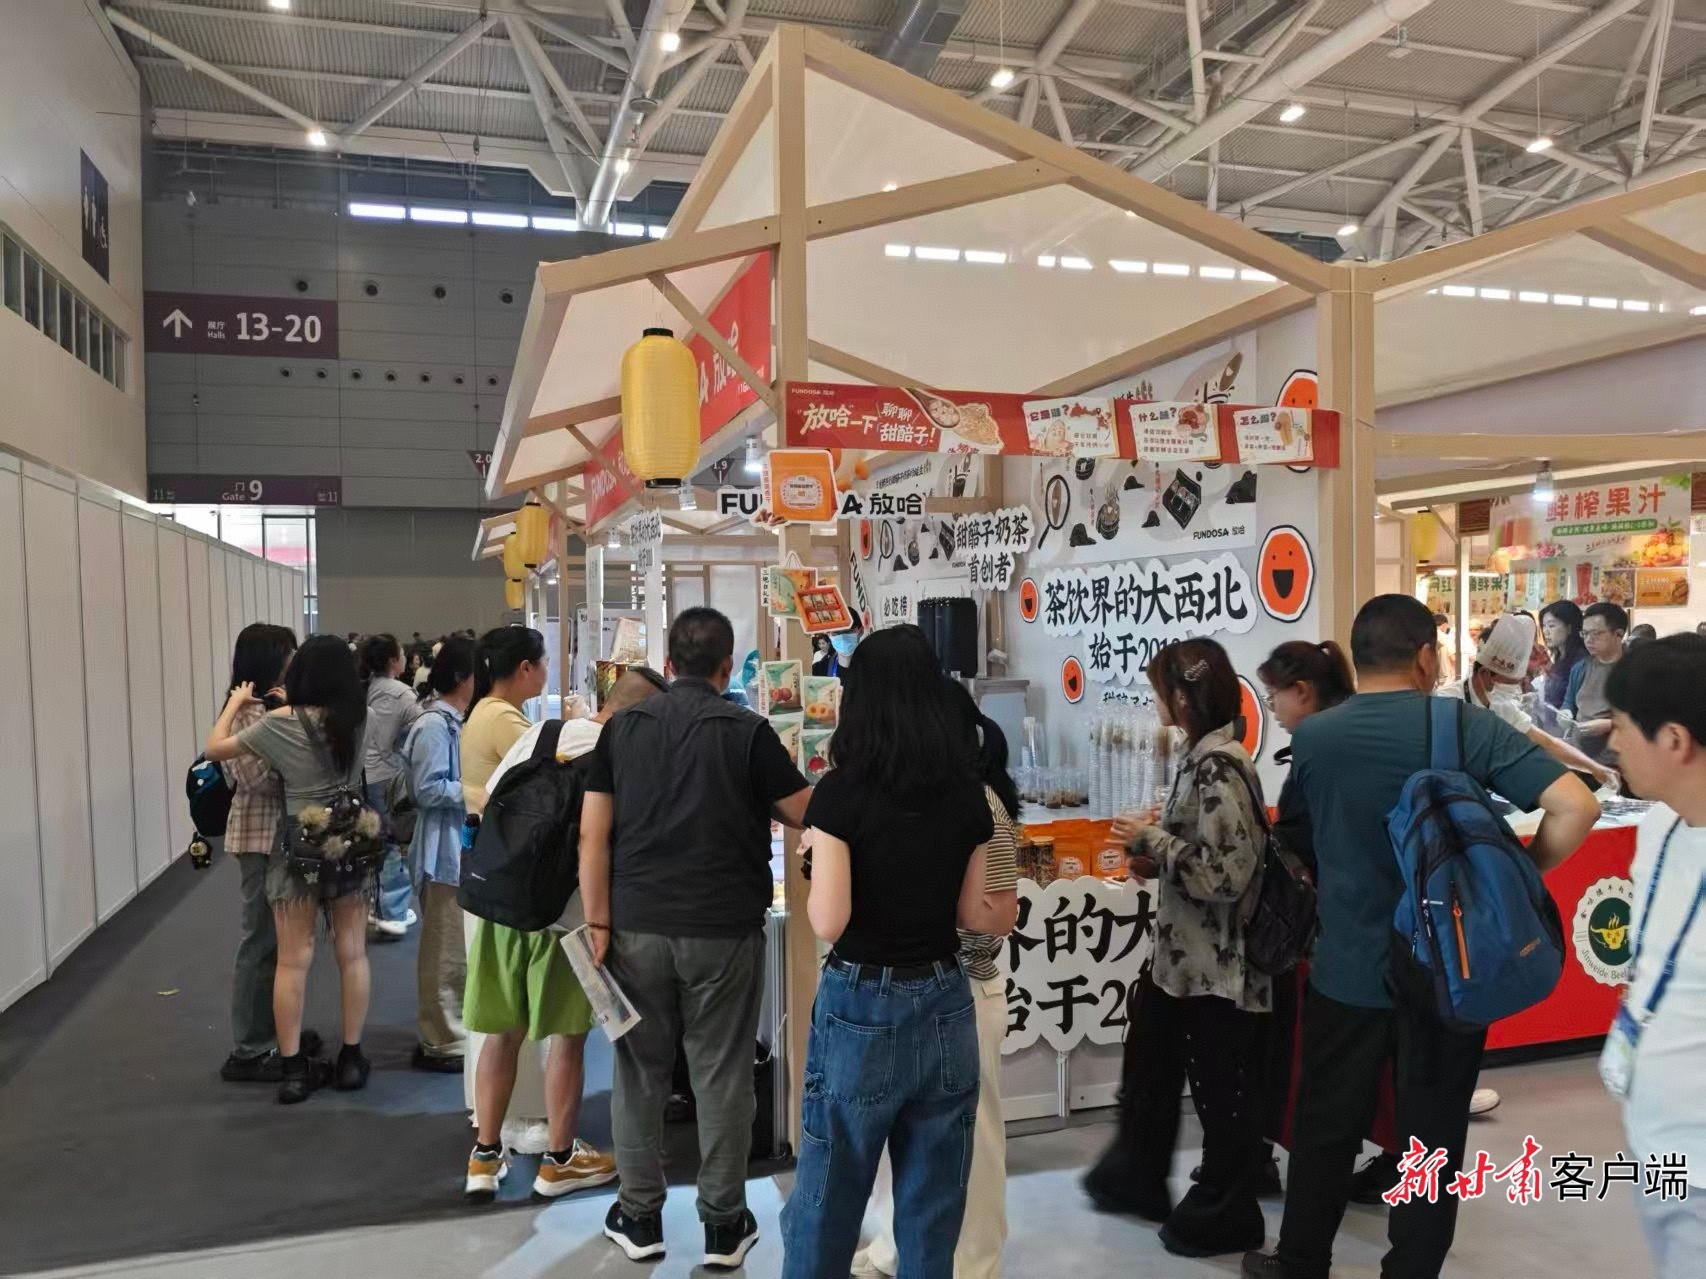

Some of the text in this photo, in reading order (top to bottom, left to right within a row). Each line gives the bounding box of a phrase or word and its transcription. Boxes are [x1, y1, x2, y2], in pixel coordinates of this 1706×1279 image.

[207, 331, 226, 340] Halls
[236, 311, 322, 343] 13-20
[881, 402, 913, 422] 聊聊
[222, 491, 245, 502] Gate
[250, 480, 263, 501] 9
[869, 493, 922, 515] 放哈
[1546, 483, 1666, 522] 鲜榨果汁
[956, 512, 1030, 550] 甜醅子奶茶
[1193, 528, 1229, 540] FUNDOSA
[967, 552, 1011, 585] 首创者
[883, 595, 908, 617] 必吃榜
[1045, 565, 1248, 628] 茶饮界的大西北
